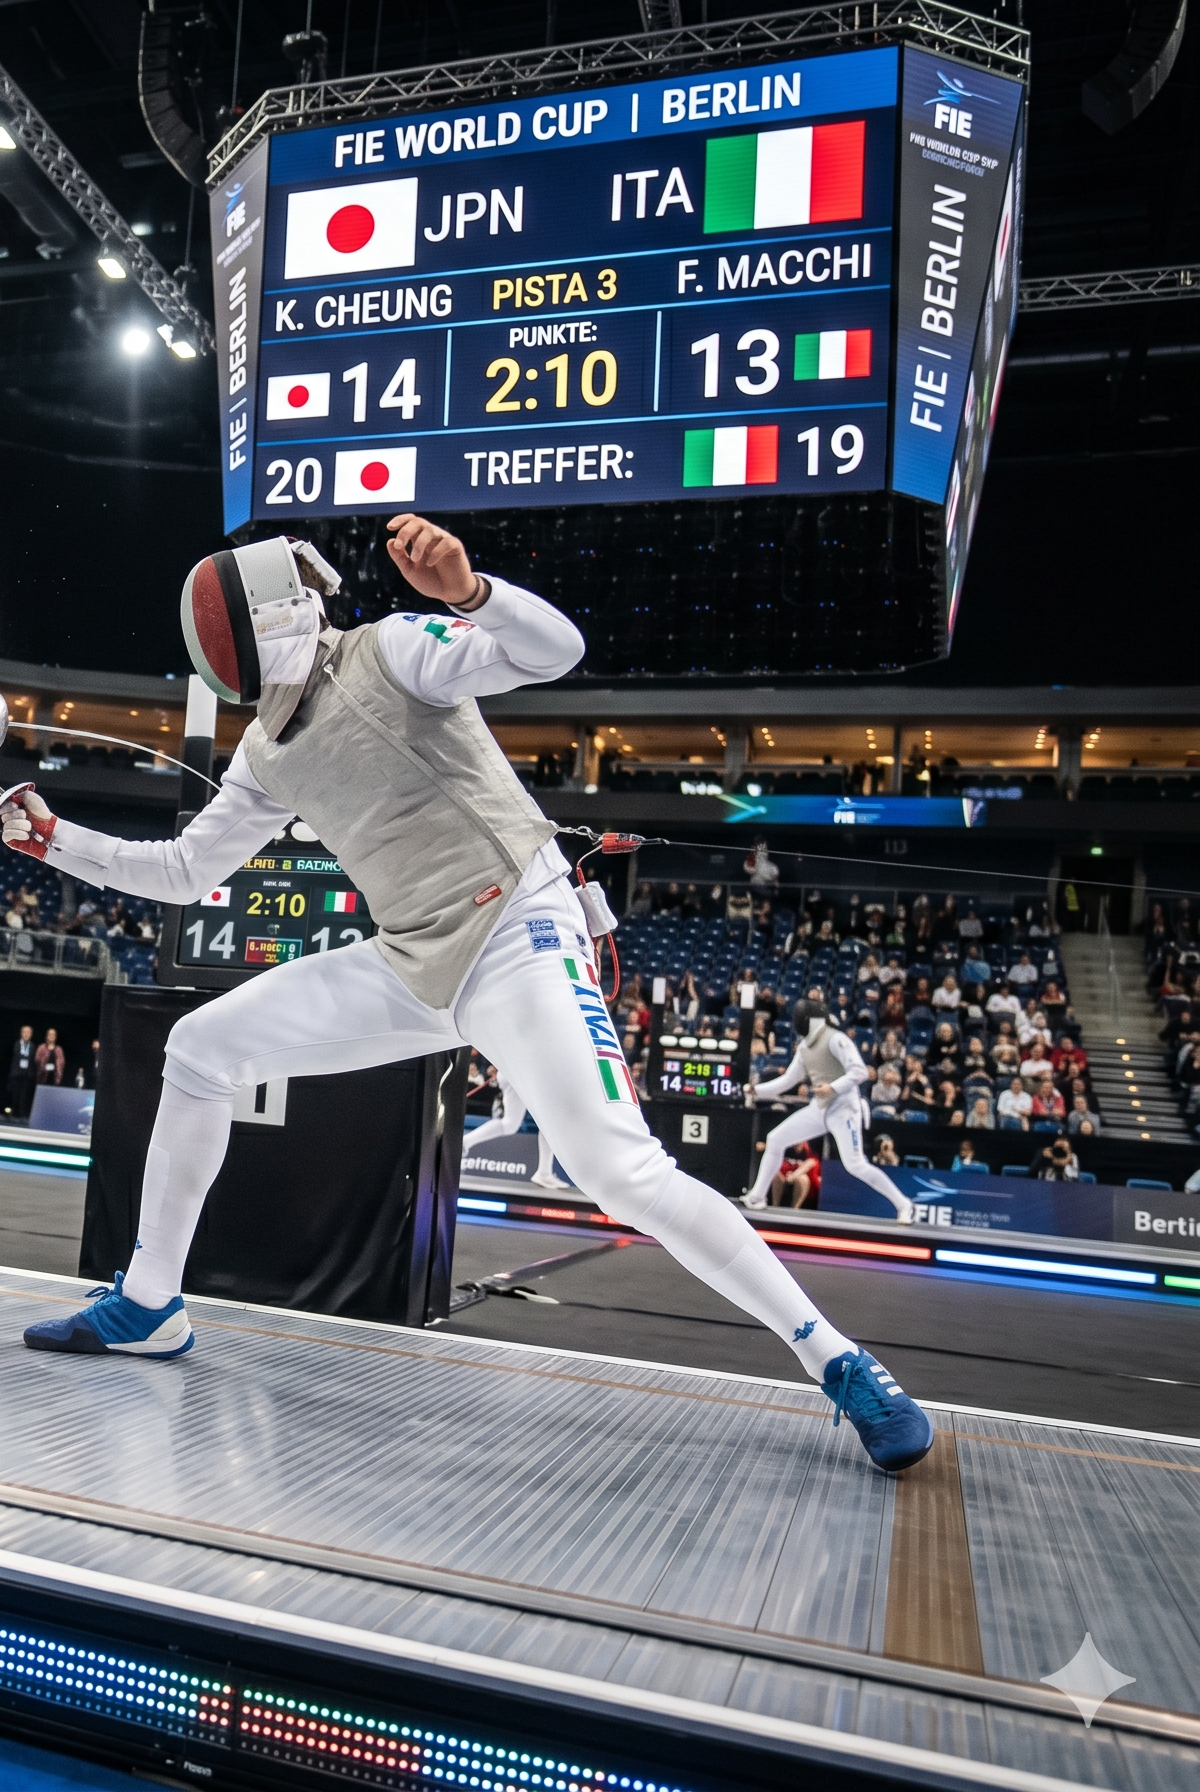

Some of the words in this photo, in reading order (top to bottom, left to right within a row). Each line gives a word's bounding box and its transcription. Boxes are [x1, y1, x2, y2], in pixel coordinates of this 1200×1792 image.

[335, 129, 385, 168] FIE
[395, 112, 521, 159] WORLD
[532, 99, 608, 140] CUP
[662, 72, 801, 124] BERLIN
[934, 103, 973, 139] FIE
[423, 185, 524, 242] JPN
[611, 166, 694, 222] ITA
[678, 259, 704, 294] F.
[717, 243, 871, 291] MACCHI
[920, 183, 967, 338] BERLIN
[275, 299, 304, 332] K.
[315, 283, 453, 329] CHEUNG
[492, 271, 589, 311] PISTA
[596, 268, 617, 301] 3
[228, 266, 247, 396] BERLIN
[509, 321, 598, 349] PUNKTE:
[485, 349, 618, 413] 2:10
[691, 328, 780, 398] 13
[342, 358, 422, 423] 14
[909, 364, 948, 433] FIE
[229, 411, 247, 472] FIE
[463, 444, 634, 487] TREFFER:
[797, 424, 864, 476] 19
[265, 457, 323, 505] 20
[246, 891, 307, 918] 2:10
[185, 919, 237, 960] 14
[689, 1121, 702, 1138] 3
[914, 1203, 953, 1227] FIE
[1134, 1209, 1200, 1238] Berti
